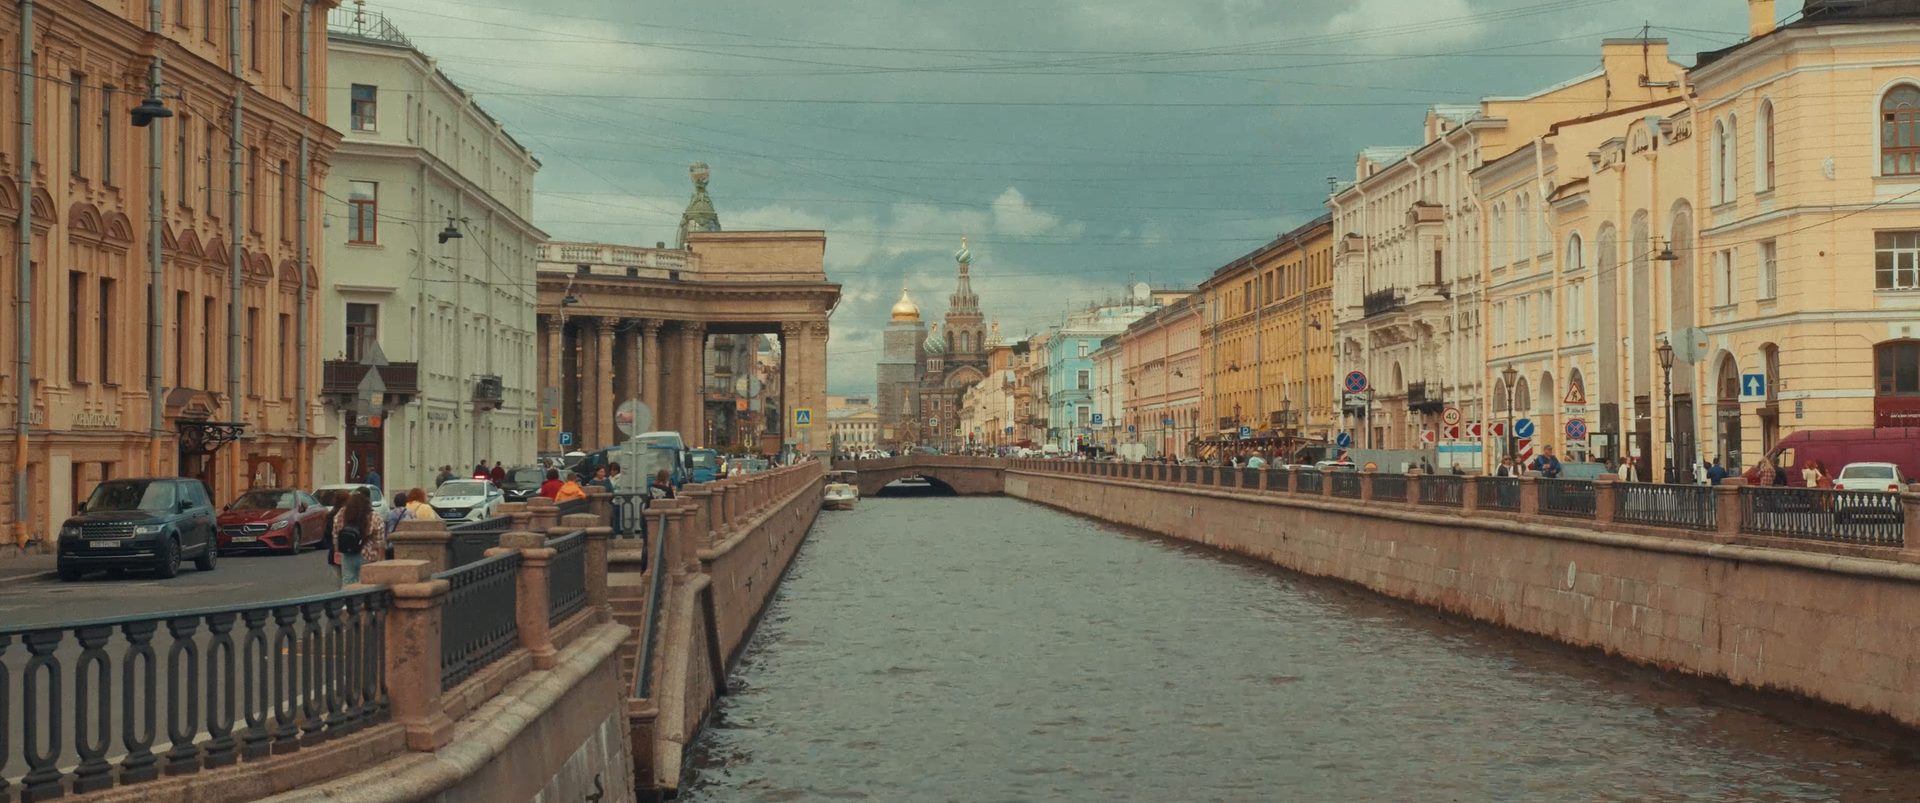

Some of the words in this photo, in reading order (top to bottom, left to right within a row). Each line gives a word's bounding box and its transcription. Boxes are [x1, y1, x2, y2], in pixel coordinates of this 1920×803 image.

[1094, 414, 1101, 424] P
[1446, 412, 1456, 420] 40
[1242, 427, 1250, 436] P
[562, 434, 569, 443] P
